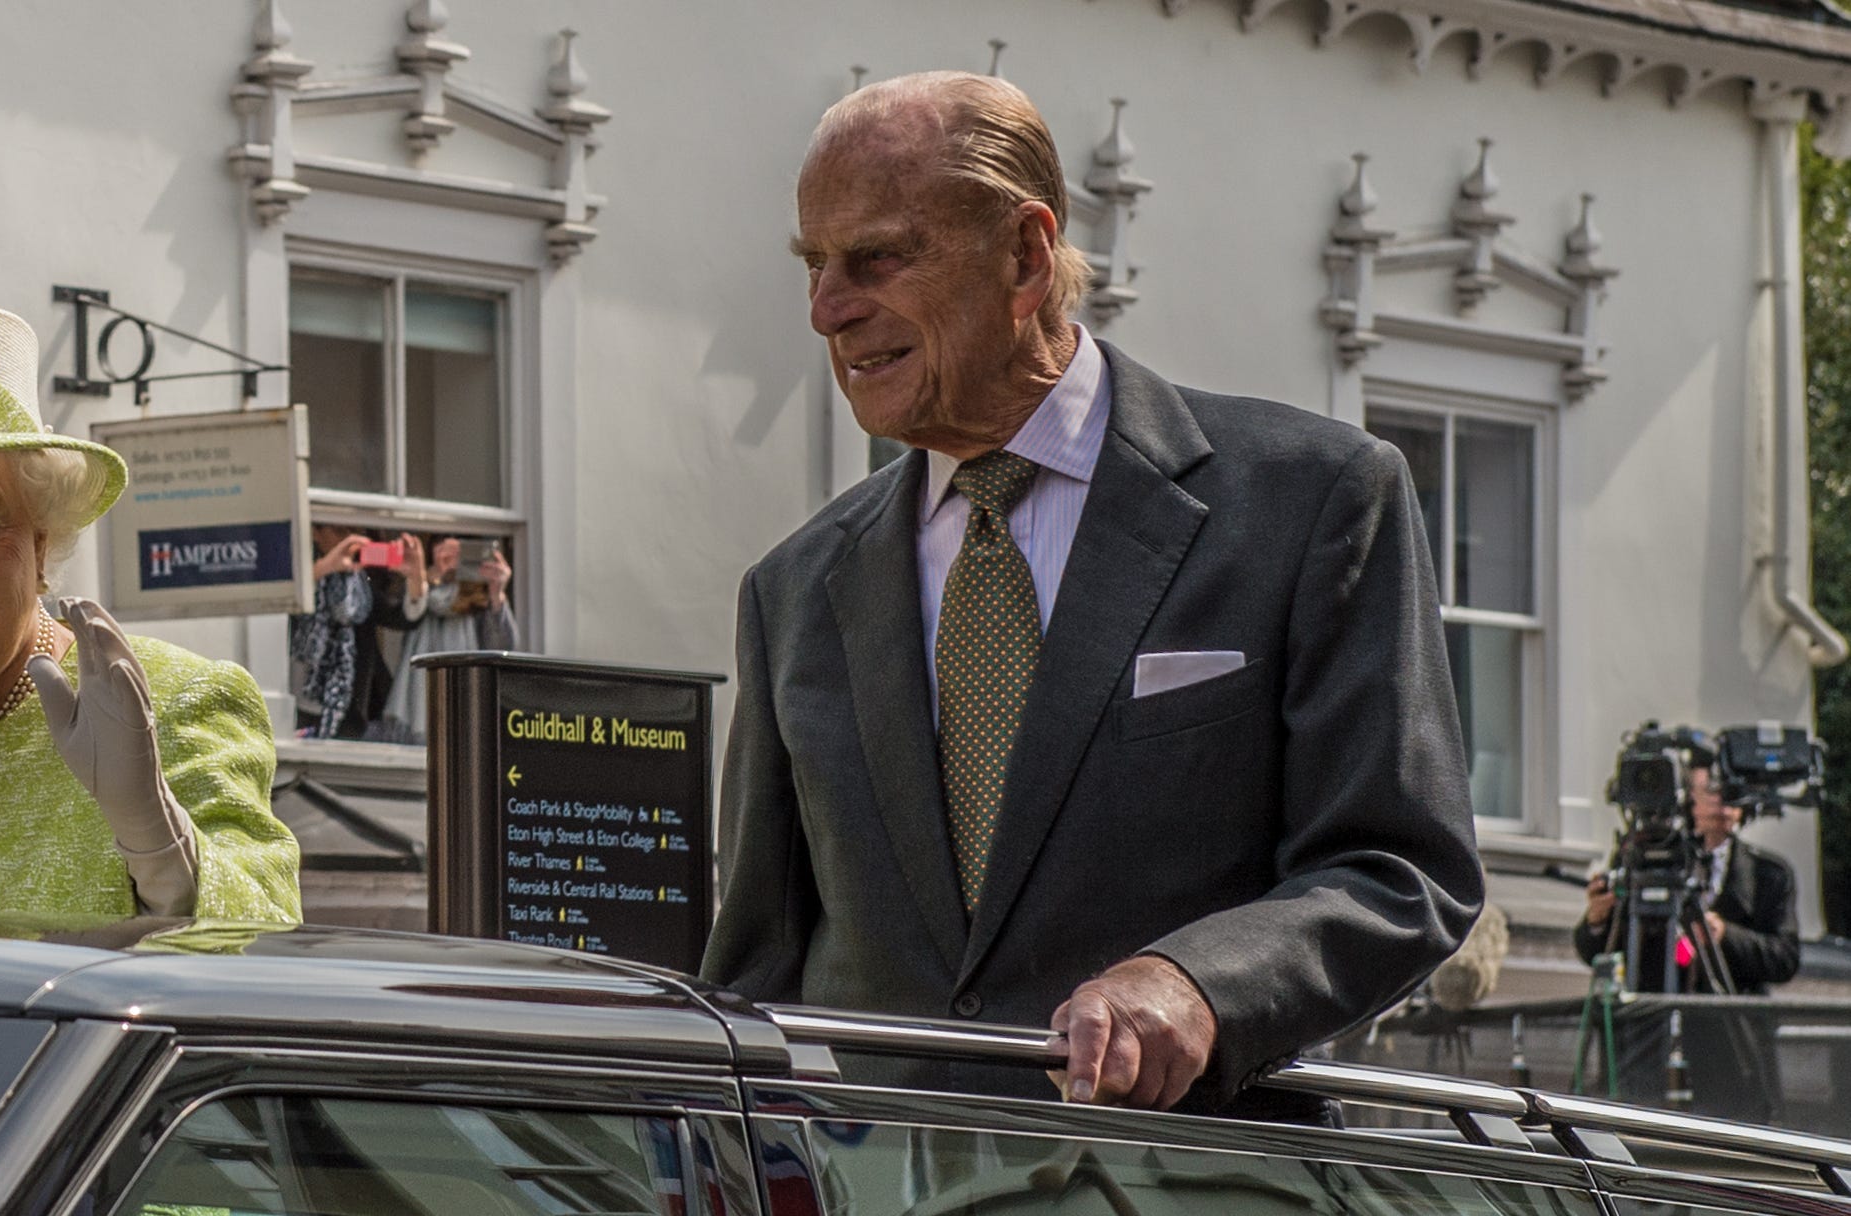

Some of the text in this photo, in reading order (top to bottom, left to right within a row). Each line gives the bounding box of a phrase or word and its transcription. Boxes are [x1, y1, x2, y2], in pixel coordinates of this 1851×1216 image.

[507, 709, 687, 751] Guildhall & Museum
[508, 797, 634, 825] Coach Park & ShopMobility
[508, 824, 530, 842] Eton
[532, 826, 554, 847] High
[557, 827, 584, 845] Street
[586, 830, 595, 845] &
[597, 830, 619, 847] Eton
[621, 831, 656, 854] College
[508, 851, 532, 868] River
[535, 852, 571, 871] Thames
[508, 877, 551, 896] Riverside
[552, 880, 561, 897] &
[562, 880, 597, 898] Central
[599, 883, 617, 900] Rail
[618, 884, 654, 902] Stations
[508, 904, 528, 921] Taxi
[530, 905, 554, 922] Rank
